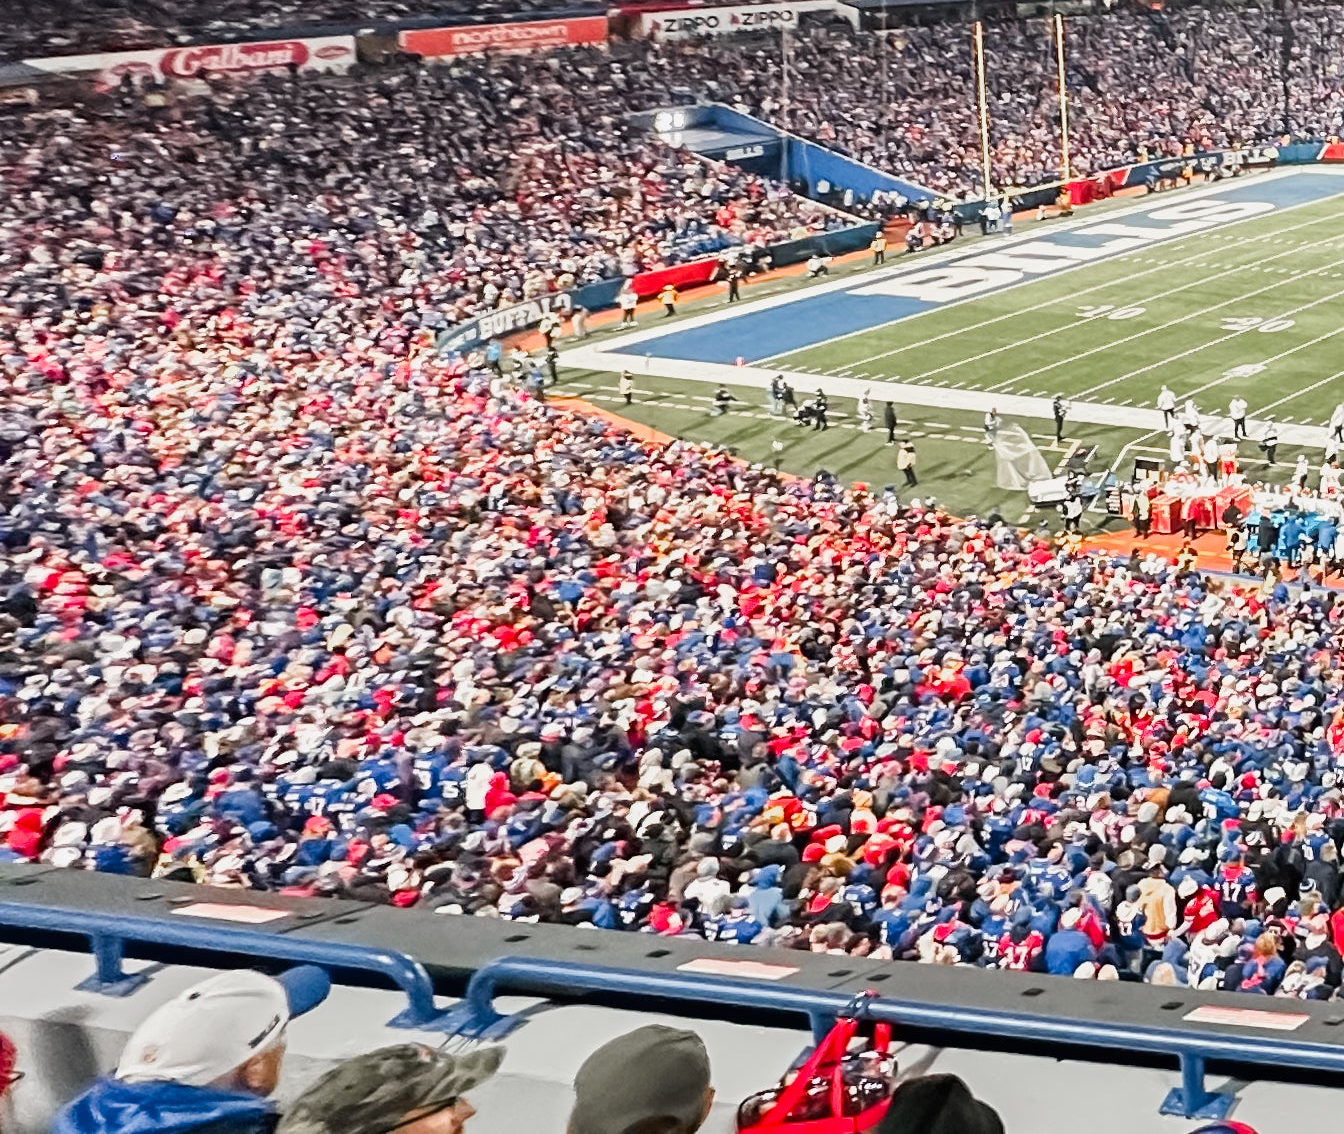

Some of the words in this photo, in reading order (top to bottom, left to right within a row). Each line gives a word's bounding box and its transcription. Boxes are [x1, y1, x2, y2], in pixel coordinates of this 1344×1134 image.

[664, 16, 719, 32] ZIPPO
[741, 10, 793, 25] ZIPPO
[452, 25, 568, 45] northtown
[172, 43, 294, 76] Galbani
[845, 199, 1275, 302] BILLS
[1222, 882, 1241, 902] 17
